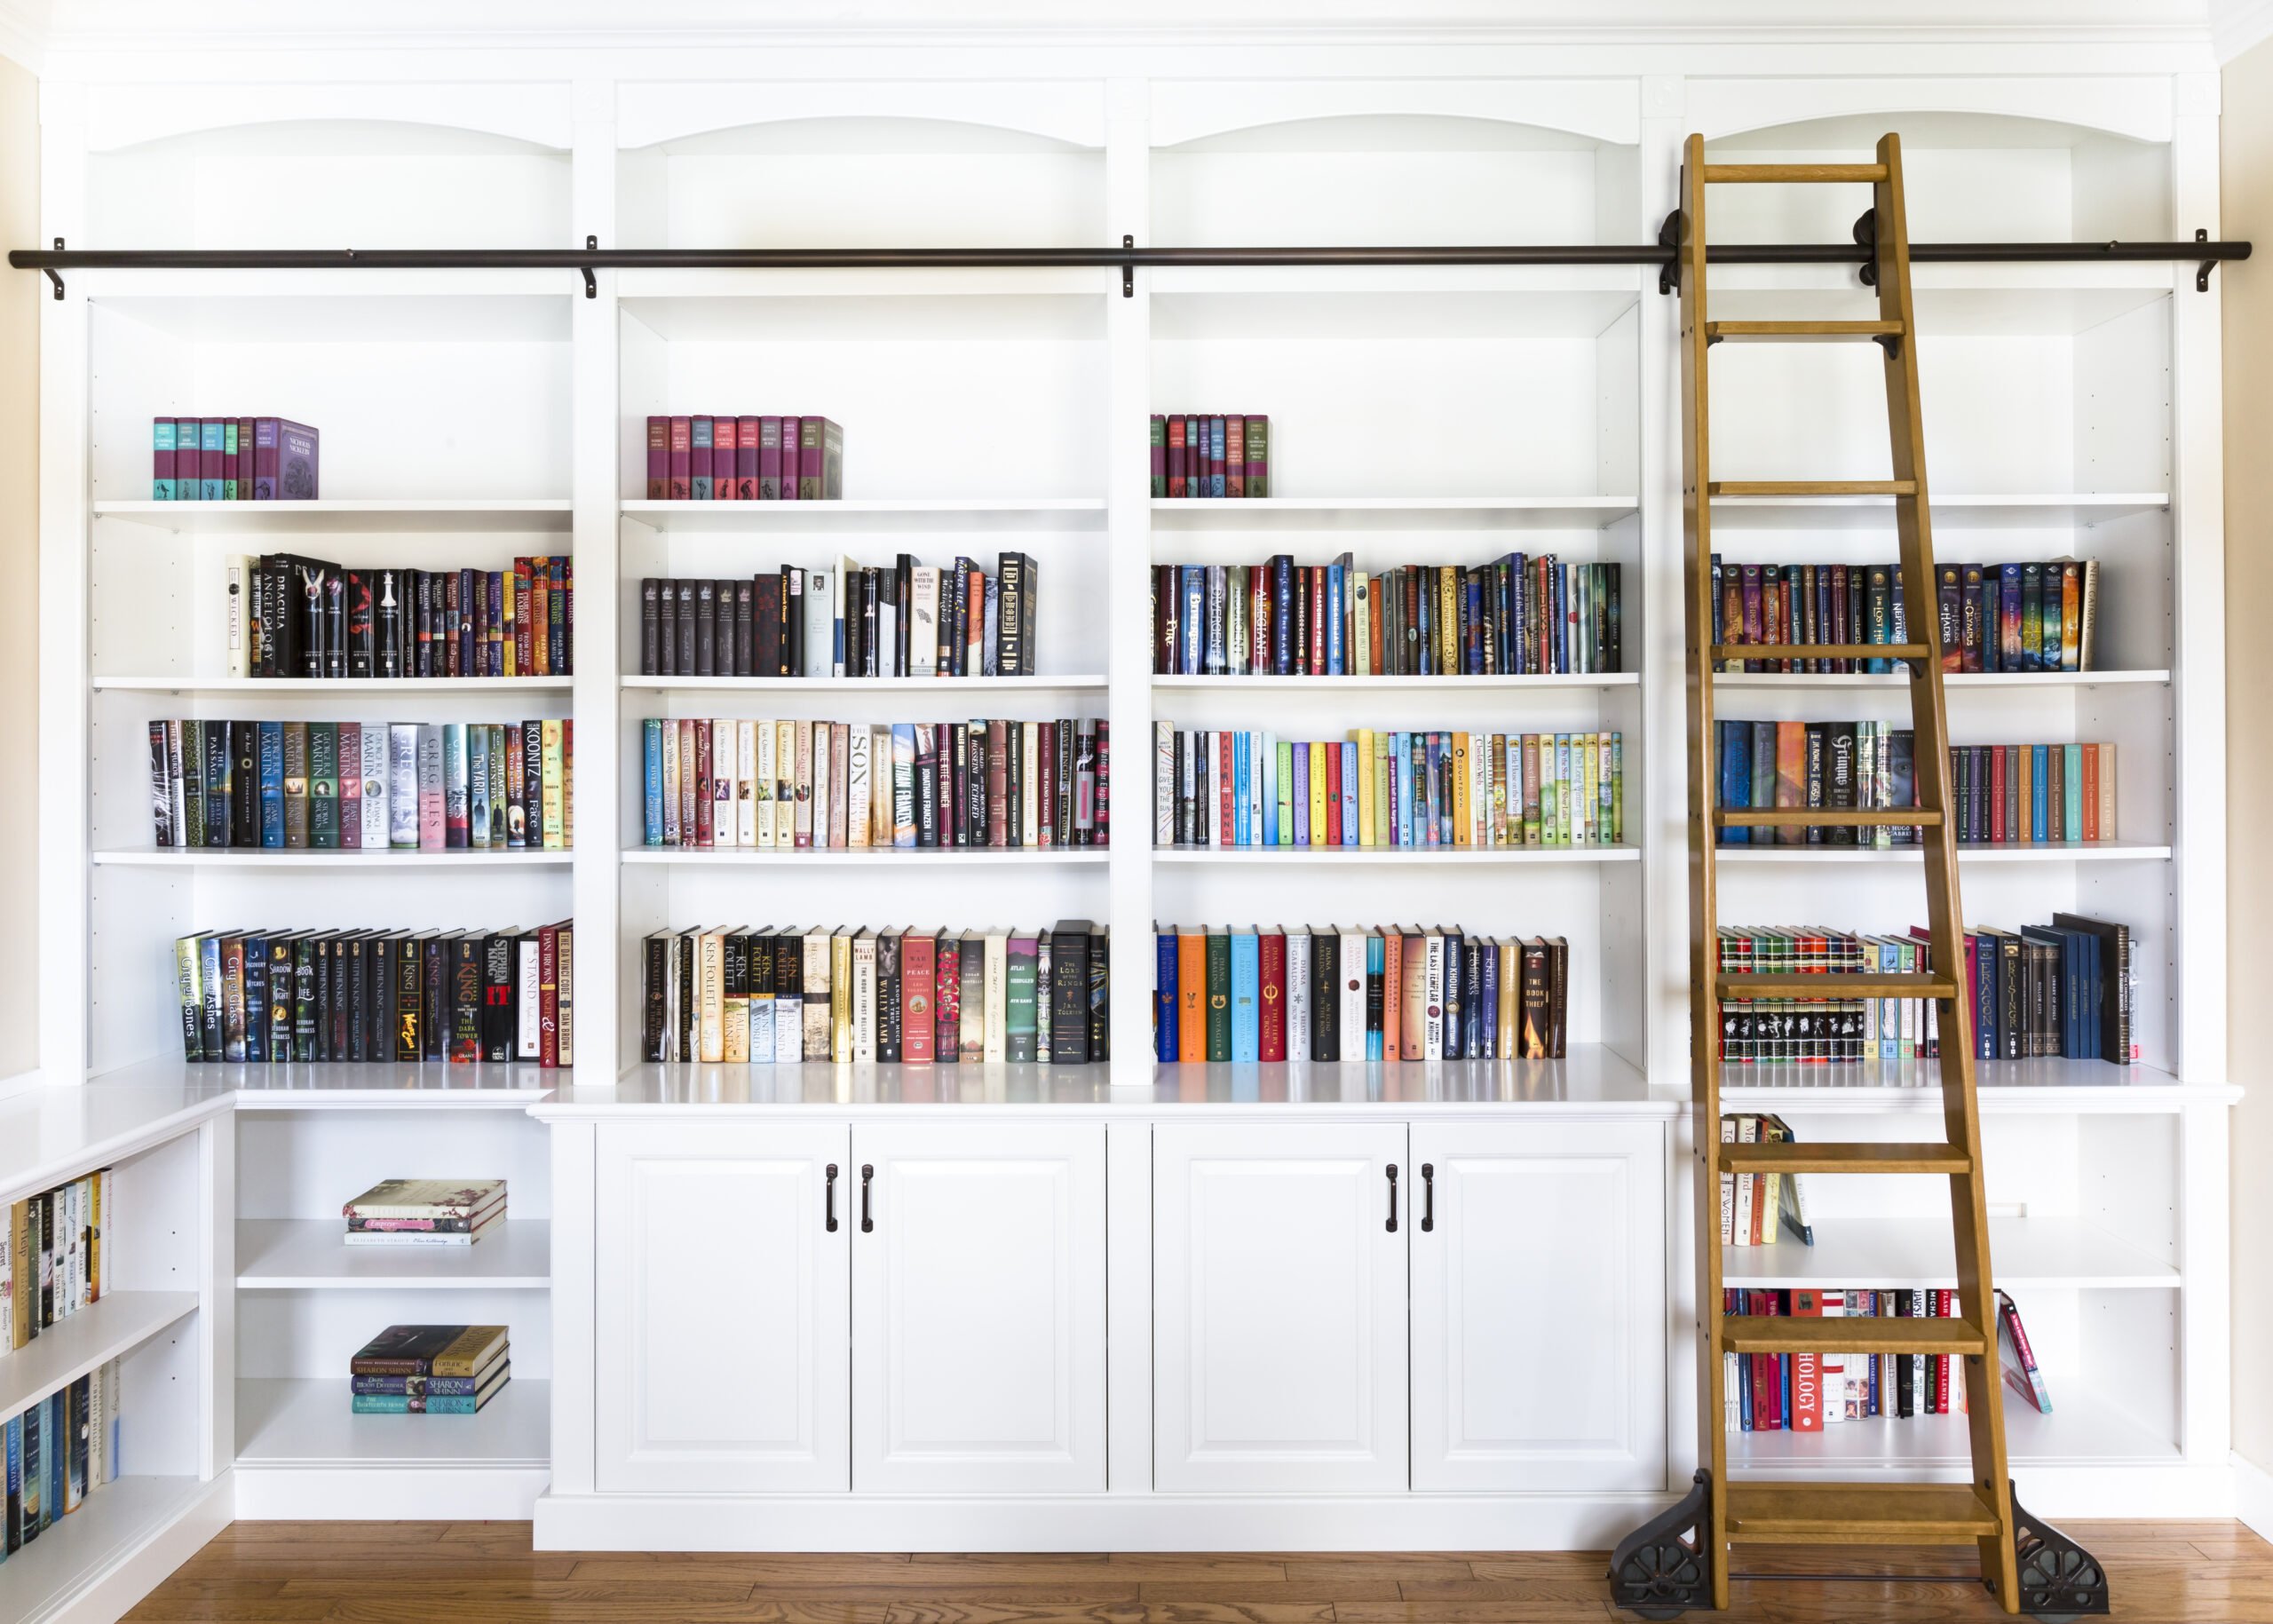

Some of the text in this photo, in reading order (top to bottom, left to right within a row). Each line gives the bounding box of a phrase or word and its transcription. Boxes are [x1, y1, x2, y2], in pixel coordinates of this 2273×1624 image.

[264, 573, 273, 661] ANGELOLOGY
[939, 579, 948, 623] Mockingbird
[2087, 566, 2097, 630] NEIL GAIMAN
[1212, 589, 1222, 657] DIVERGENT
[1234, 588, 1244, 657] INSURGENT
[1256, 589, 1267, 658] ALLEGIANT
[1941, 613, 1952, 643] HADES
[1965, 606, 1975, 646] OLYMPUS
[261, 732, 272, 777] MARTIN
[286, 732, 295, 776] MARTIN
[313, 733, 322, 777] MARTIN
[340, 733, 350, 777] MARTIN
[364, 733, 374, 777] MARTIN
[473, 754, 485, 794] The YARD
[527, 727, 541, 777] KOONTZ
[851, 735, 867, 788] SON
[1099, 748, 1109, 769] Water
[1831, 734, 1853, 786] Grimm's
[400, 732, 414, 824] GREG ILES
[428, 738, 440, 828] GREG ILES
[922, 768, 931, 829] JONATHAN FRANZEN
[940, 764, 949, 808] KITE RUNNER
[1097, 782, 1108, 818] Elephants
[1572, 766, 1582, 808] Long Winter
[529, 800, 539, 828] Face
[402, 964, 416, 990] KING
[487, 947, 499, 976] KING
[493, 939, 508, 984] STEPHEN
[527, 957, 538, 1000] STAND
[543, 933, 551, 985] DAN BROWN
[653, 962, 661, 991] FOLLETT
[706, 942, 717, 1009] KEN FOLLETT
[725, 946, 735, 988] FOLLETT
[736, 955, 746, 978] KEN
[752, 947, 761, 984] FOLLETT
[762, 955, 772, 975] KEN
[778, 947, 787, 988] FOLLETT
[788, 956, 797, 978] KEN
[1430, 942, 1439, 1002] THE LAST TEMPLAR
[180, 956, 195, 1037] City of Bones
[204, 956, 218, 1030] City Ashes
[226, 956, 240, 1024] City of Glass
[456, 962, 475, 1002] KING
[487, 986, 511, 1006] IT
[560, 934, 570, 1051] THE DA VINCI CODE DAN BROWN
[1449, 968, 1458, 999] KHOURY
[1981, 963, 1992, 1026] ERAGON
[2008, 959, 2018, 1028] BRISINGR
[879, 979, 888, 1044] WALLY LAMB
[18, 1229, 28, 1257] Help
[1913, 1290, 1922, 1312] LIAR'S
[430, 1380, 463, 1389] SHARON
